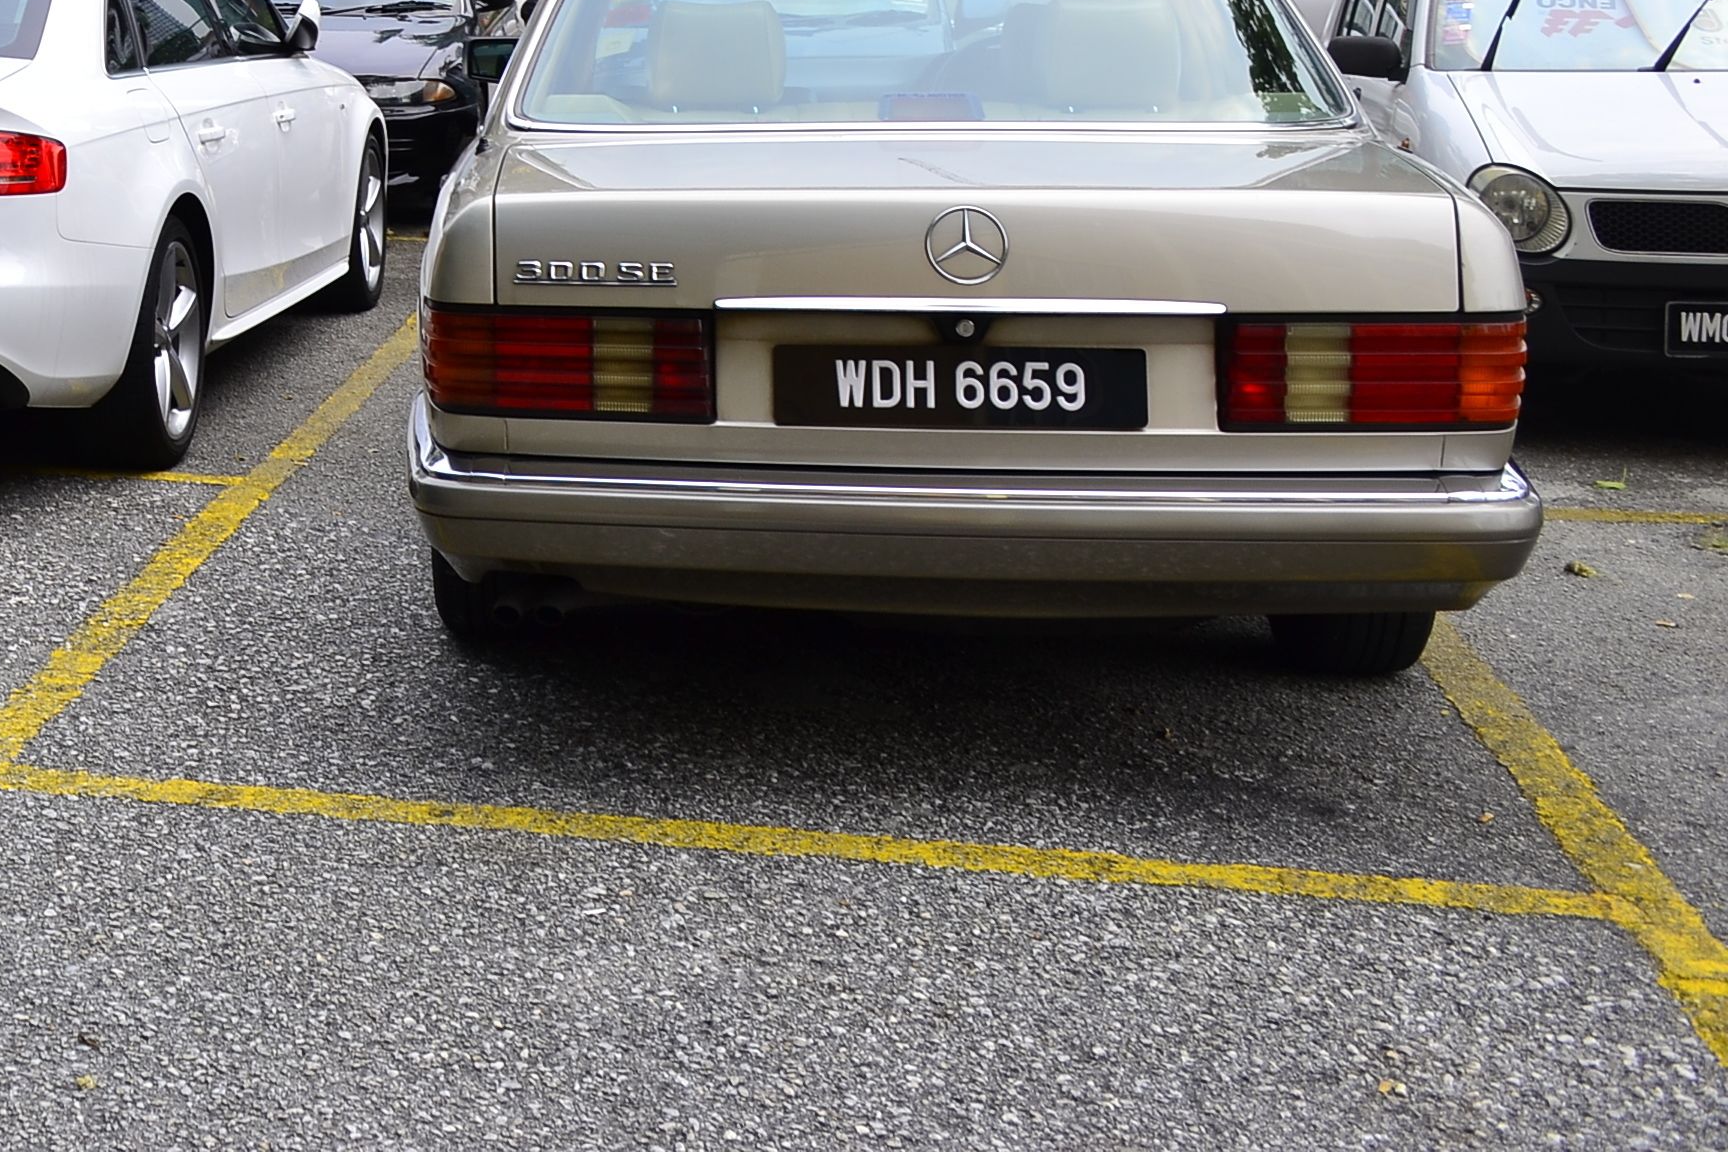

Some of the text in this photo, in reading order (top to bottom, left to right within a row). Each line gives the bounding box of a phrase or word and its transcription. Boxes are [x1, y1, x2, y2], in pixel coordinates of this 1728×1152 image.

[516, 259, 675, 281] 300 SE
[835, 359, 1086, 412] WDH 6659
